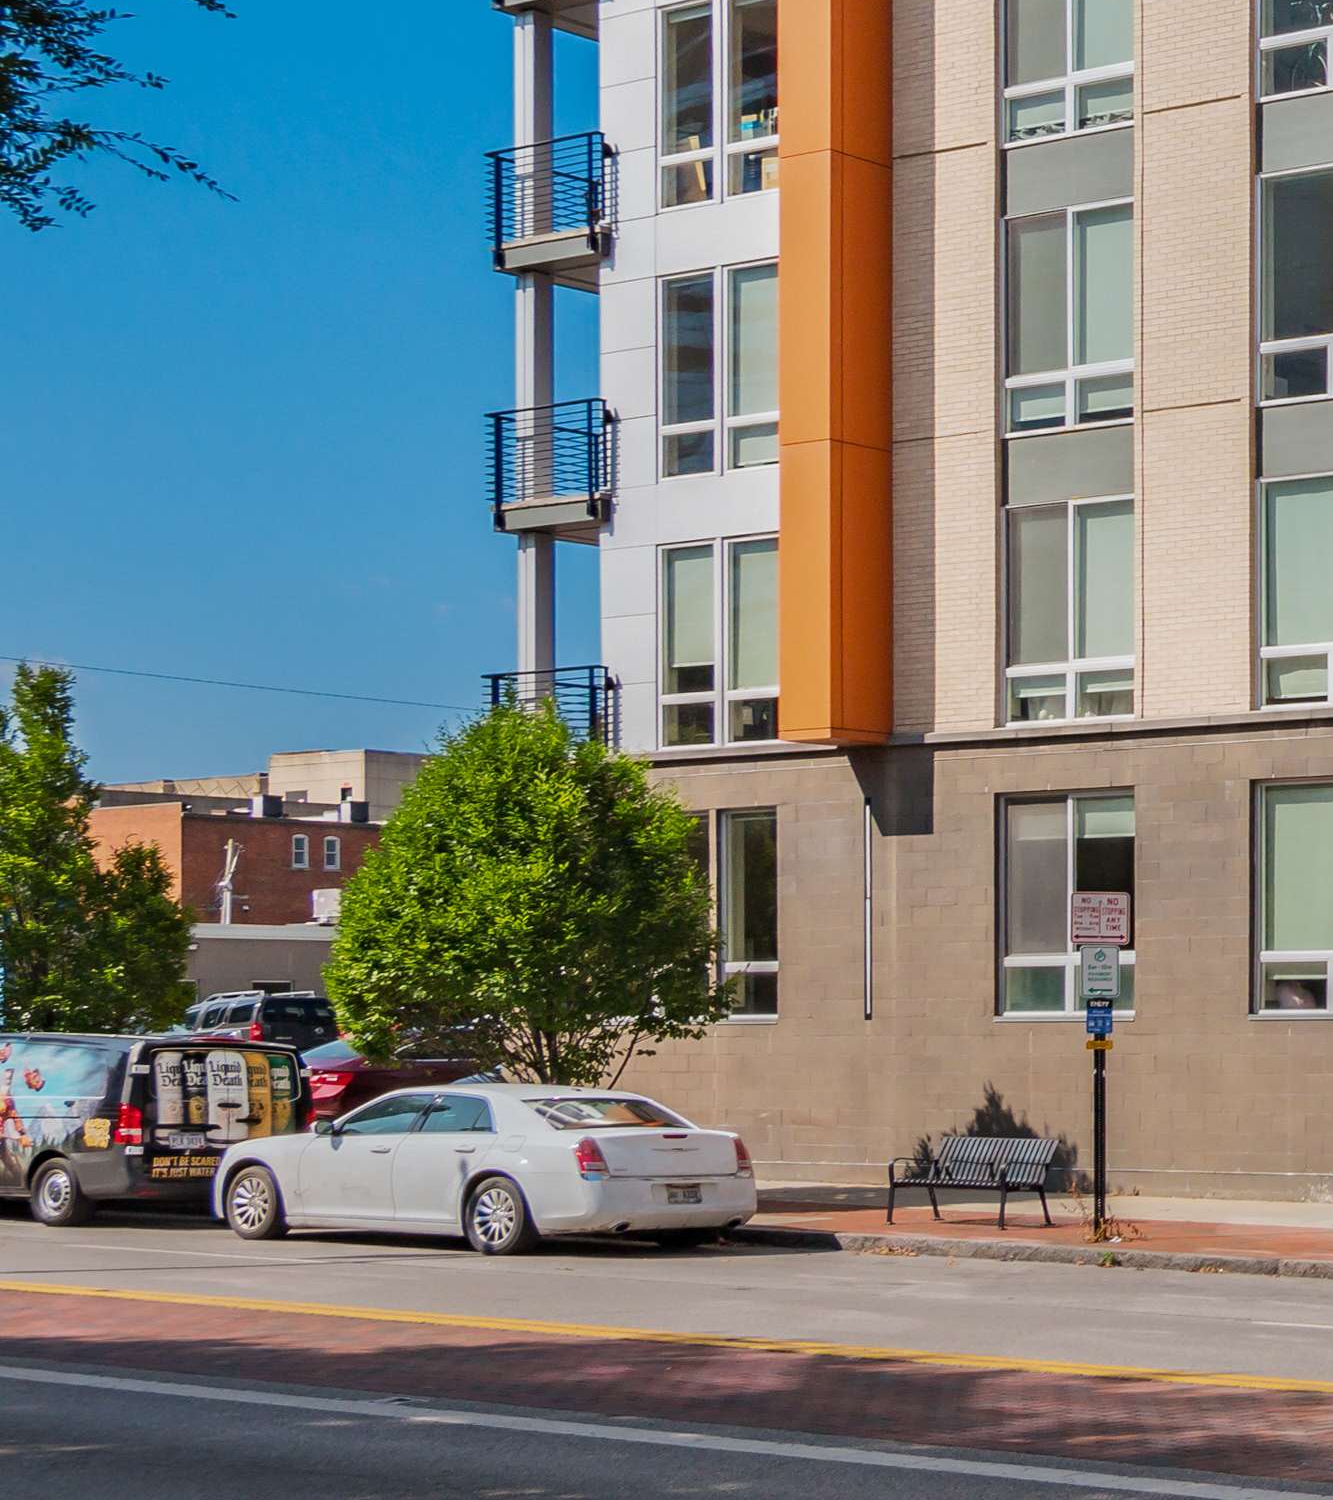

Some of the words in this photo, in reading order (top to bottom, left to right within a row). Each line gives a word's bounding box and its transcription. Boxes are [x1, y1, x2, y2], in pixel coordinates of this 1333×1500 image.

[1107, 898, 1119, 906] NO
[208, 1061, 241, 1075] Liquid
[212, 1074, 243, 1086] Death
[153, 1156, 177, 1166] DON'T
[179, 1156, 189, 1166] BE
[168, 1168, 188, 1177] JUST
